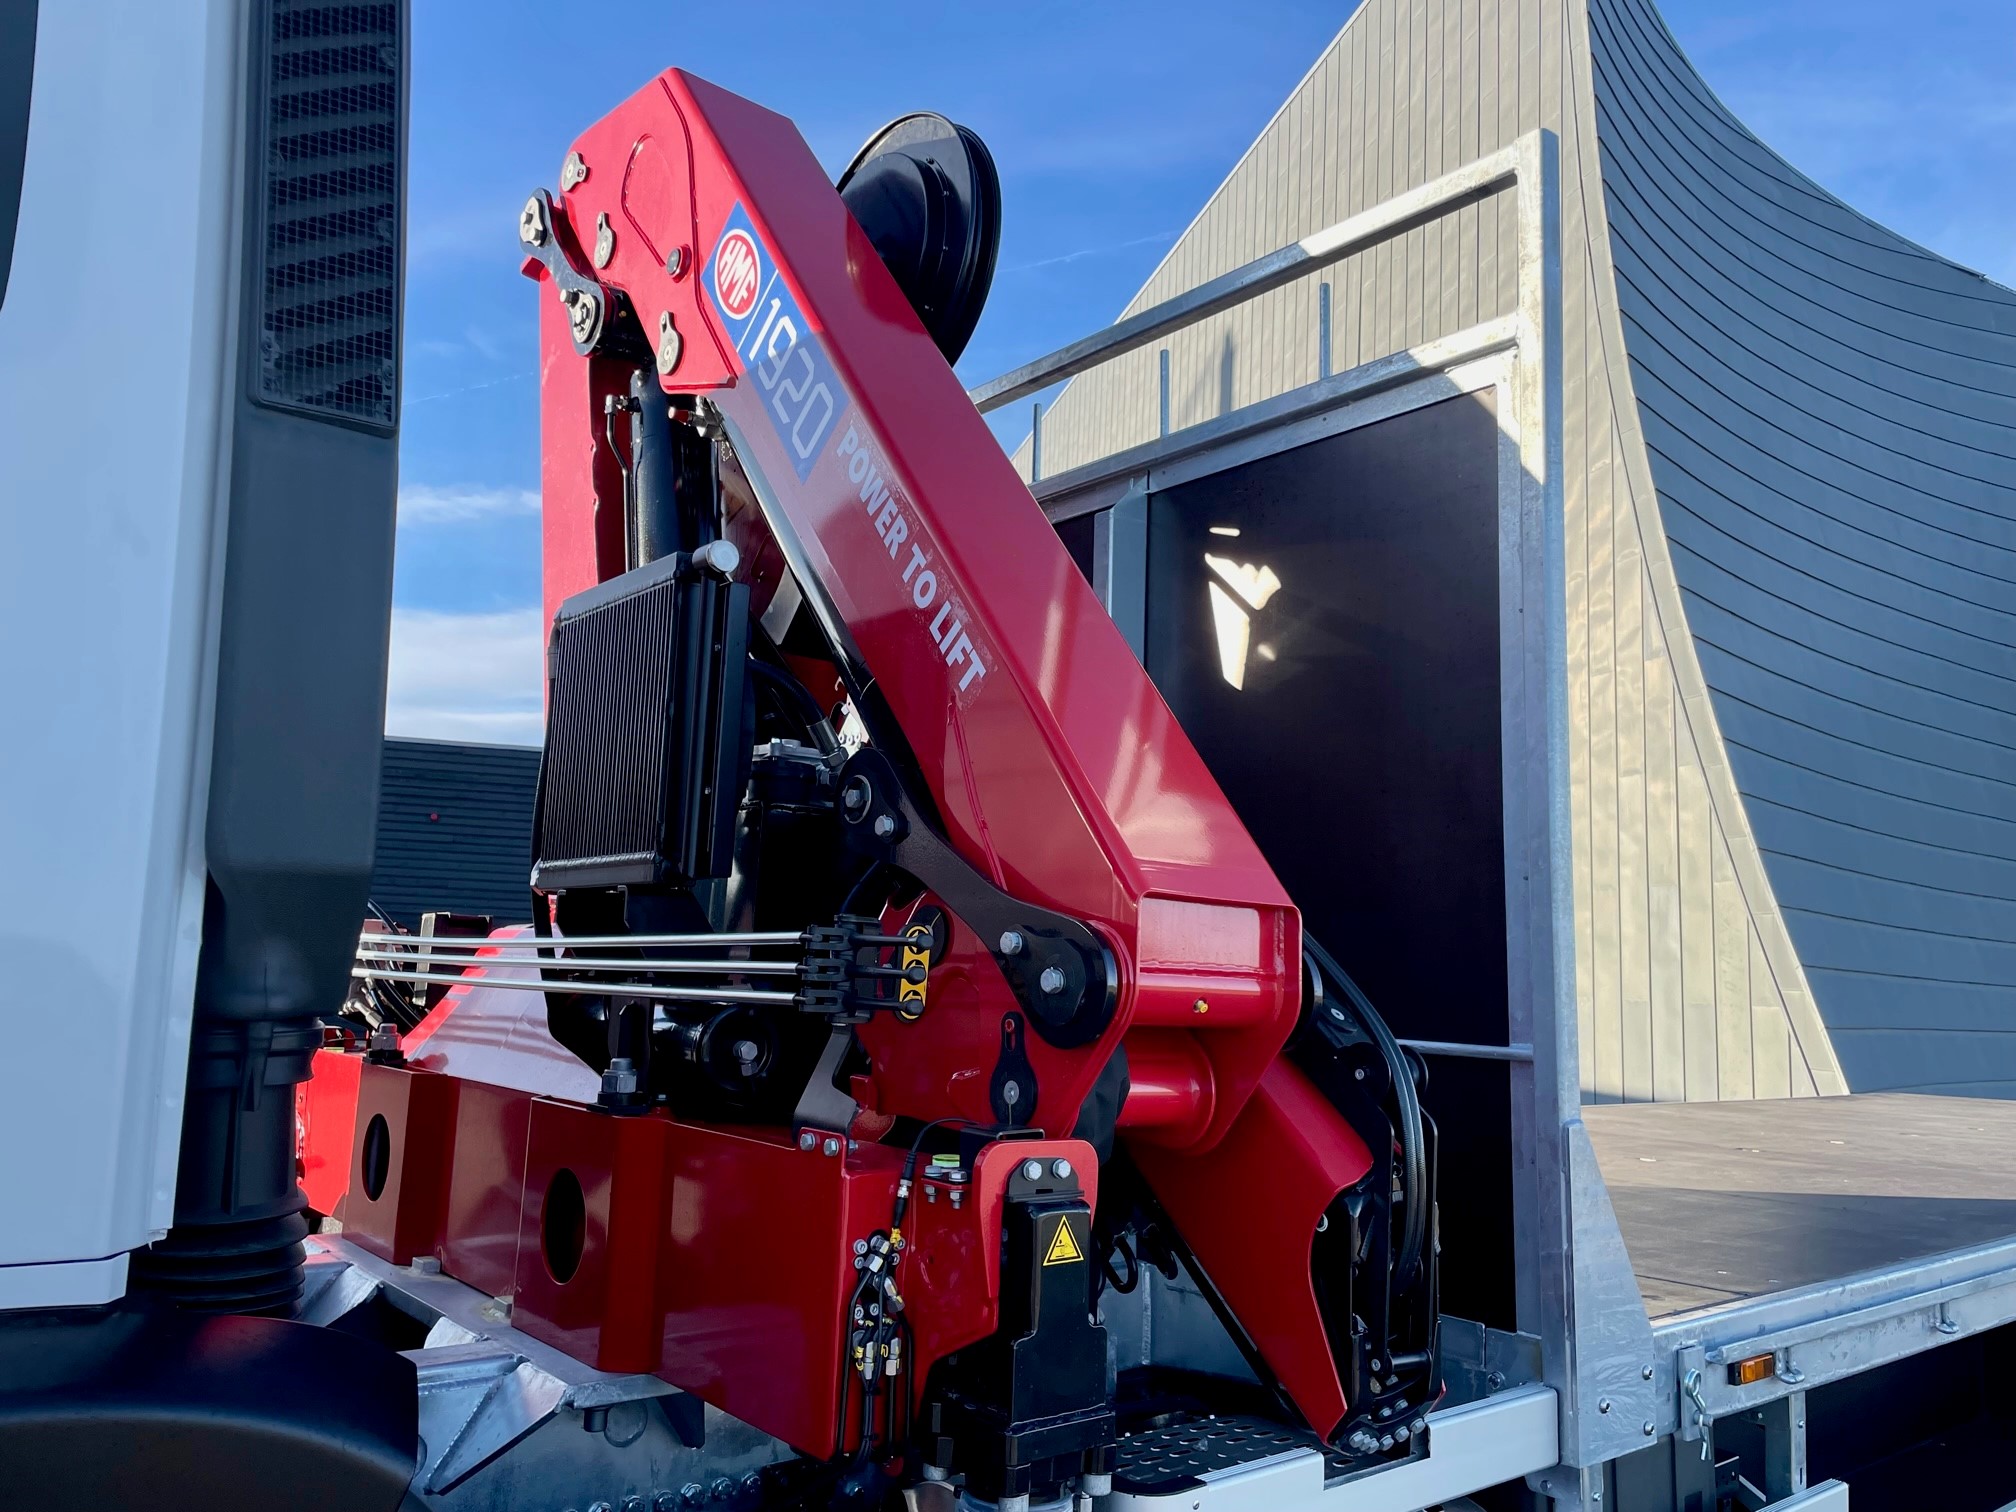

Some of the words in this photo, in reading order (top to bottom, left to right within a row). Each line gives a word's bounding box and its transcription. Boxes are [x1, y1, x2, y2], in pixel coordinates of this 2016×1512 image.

[718, 239, 757, 309] HMF
[749, 298, 834, 460] 1920
[836, 426, 909, 559] POWER
[901, 543, 938, 610] TO
[929, 601, 987, 692] LIFT
